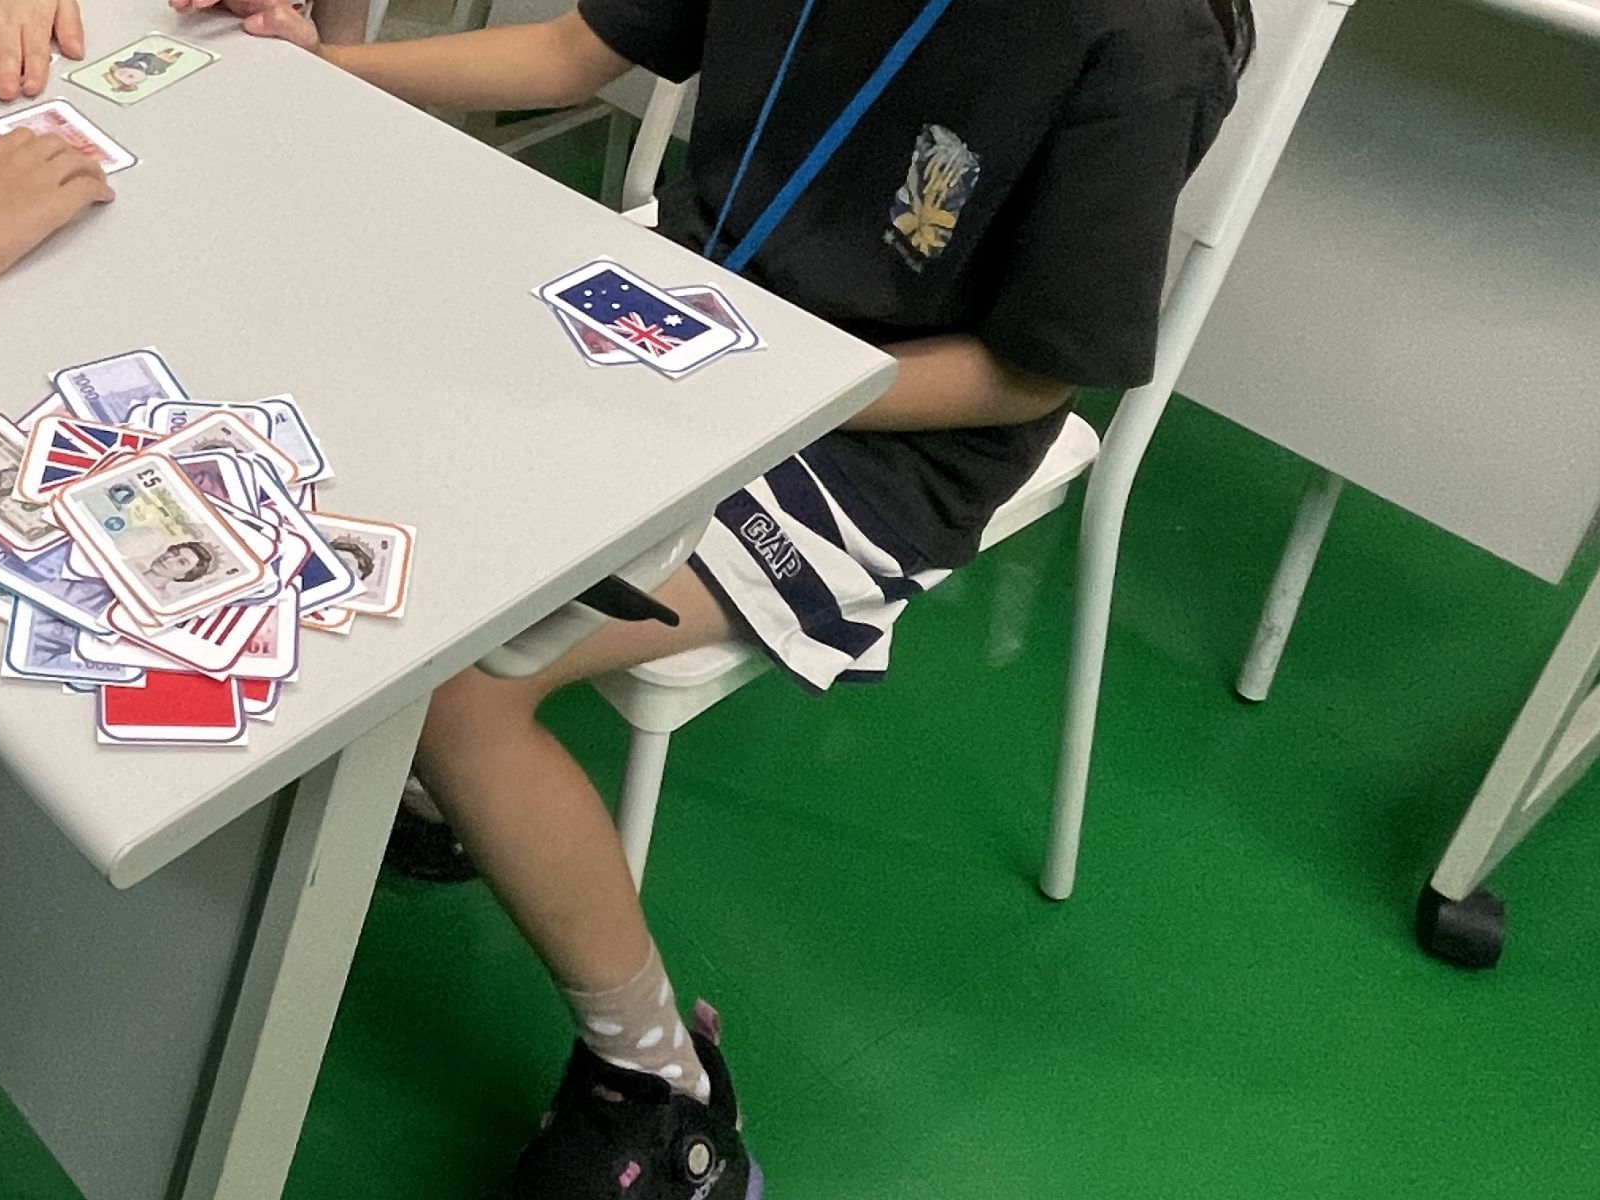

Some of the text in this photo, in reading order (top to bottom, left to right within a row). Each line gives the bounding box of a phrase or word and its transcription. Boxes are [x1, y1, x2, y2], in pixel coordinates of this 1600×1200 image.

[72, 371, 100, 402] 1000
[137, 468, 162, 489] £5
[740, 512, 802, 580] GAP
